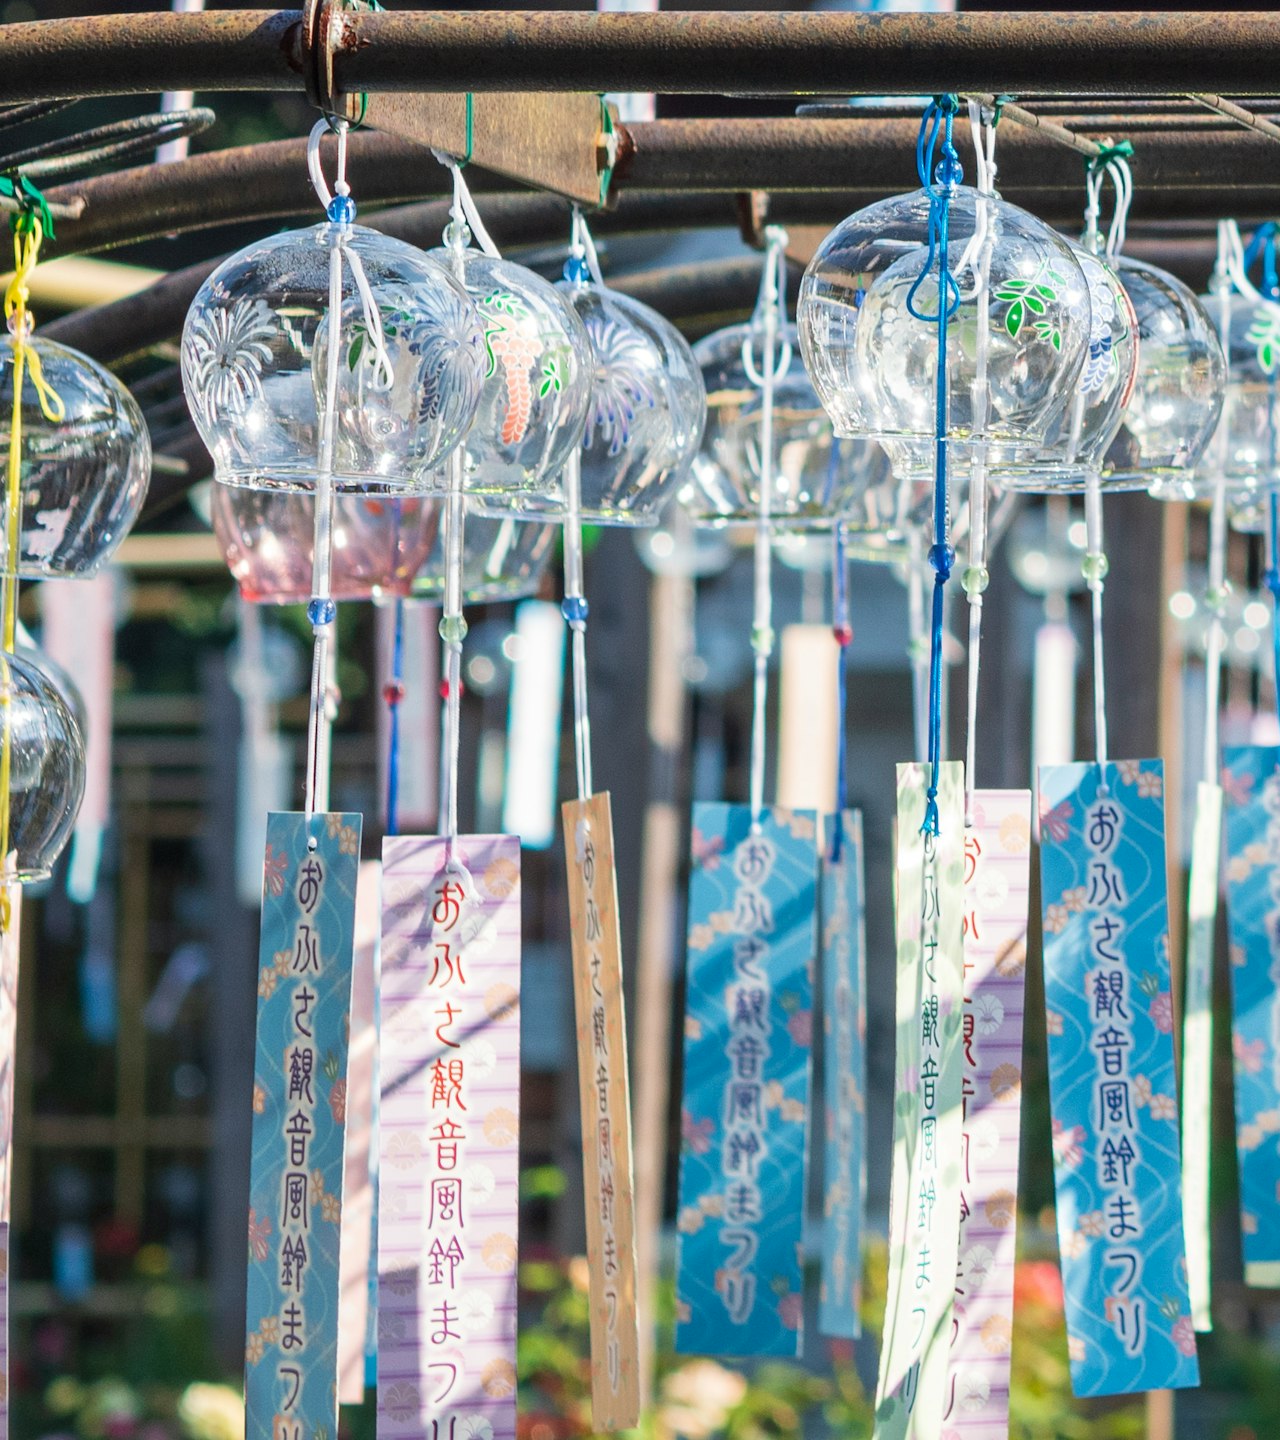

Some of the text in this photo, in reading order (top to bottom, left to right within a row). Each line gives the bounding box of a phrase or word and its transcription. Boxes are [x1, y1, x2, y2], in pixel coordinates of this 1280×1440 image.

[279, 860, 322, 1440] おふさ観音風鈴まつ
[725, 844, 772, 1320] おふさ観音風鈴まつり
[1087, 804, 1143, 1354] おふさ観音風鈴まつり
